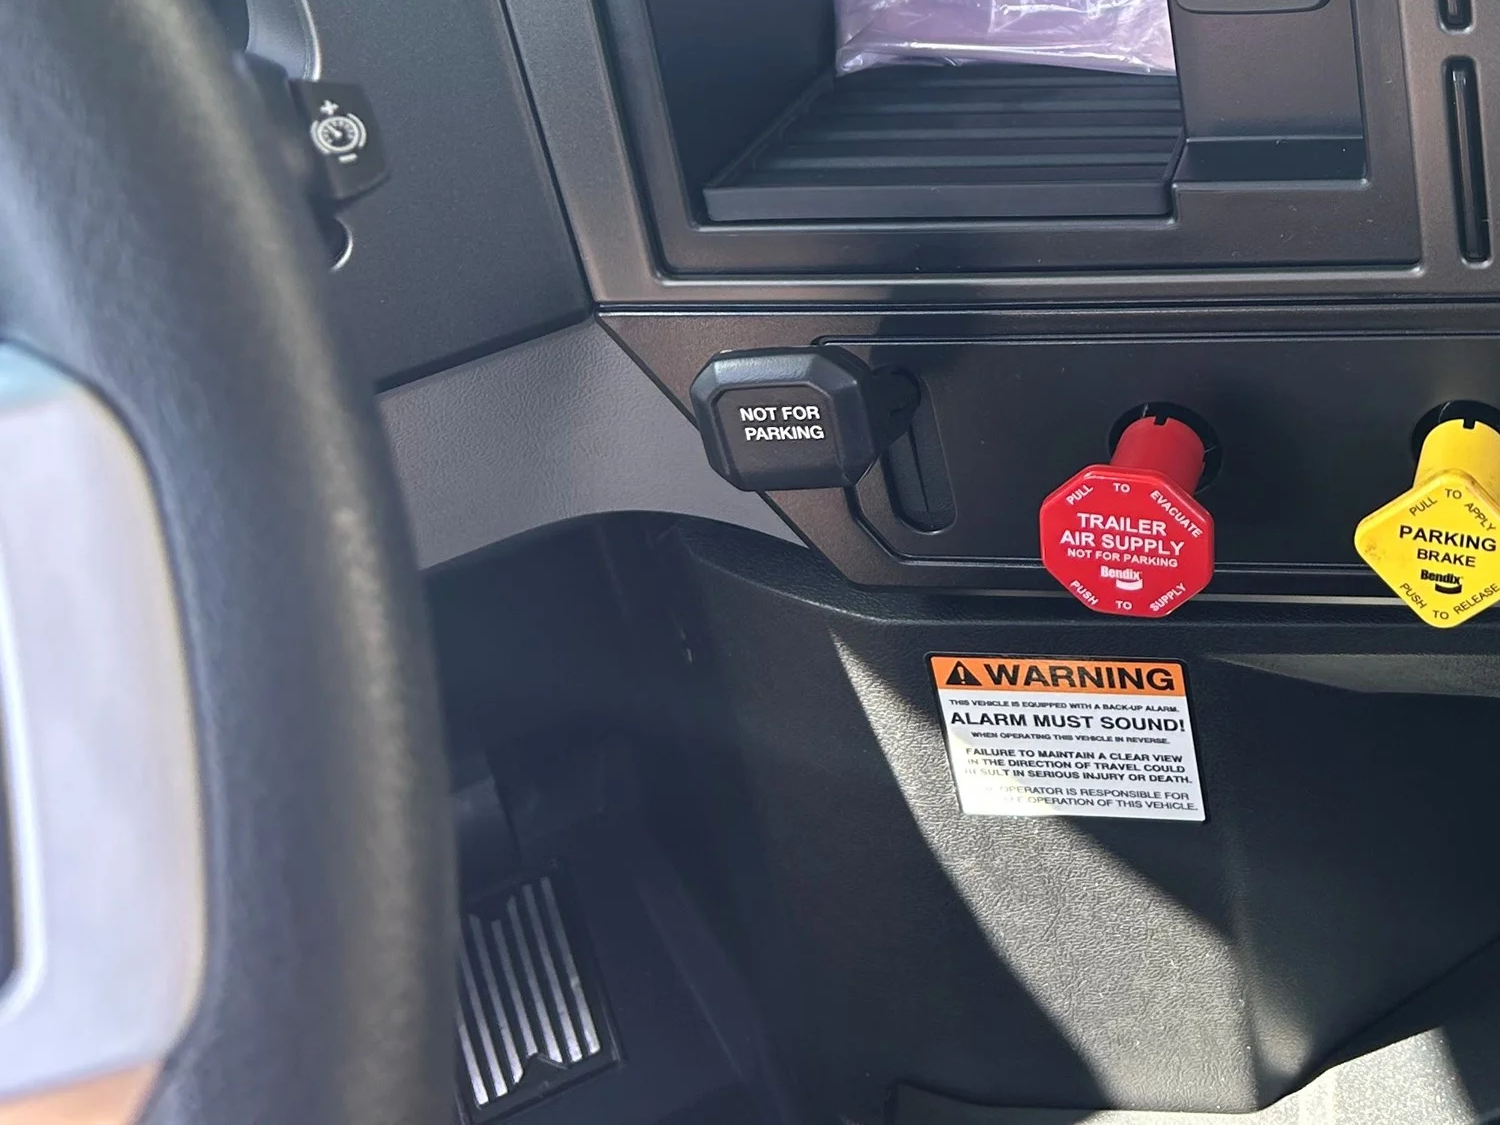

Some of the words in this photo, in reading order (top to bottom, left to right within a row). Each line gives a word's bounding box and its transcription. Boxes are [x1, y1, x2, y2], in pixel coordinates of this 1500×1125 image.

[739, 407, 777, 422] NOT
[781, 405, 821, 421] FOR
[744, 425, 825, 441] PARKING
[1065, 483, 1094, 506] PULL
[1112, 482, 1131, 494] TO
[1150, 490, 1204, 539] EVACUATE
[1408, 496, 1438, 517] PULL
[1444, 488, 1462, 500] TO
[1464, 502, 1496, 532] APPLY
[1076, 512, 1167, 536] TRAILER
[1060, 530, 1096, 547] AIR
[1101, 534, 1185, 556] SUPPLY
[1399, 525, 1497, 552] PARKING
[1067, 547, 1092, 559] NOT
[1095, 550, 1120, 562] FOR
[1123, 553, 1179, 568] PARKING
[1417, 548, 1476, 568] BRAKE
[1100, 565, 1140, 581] Bendix
[1420, 568, 1461, 585] Bendix
[1069, 579, 1099, 606] PUSH
[1115, 600, 1133, 611] TO
[1149, 582, 1187, 612] SUPPLY
[1399, 583, 1428, 609] PUSH
[1432, 610, 1450, 620] TO
[1453, 583, 1500, 615] RELEASE
[984, 663, 1175, 691] WARNING
[951, 712, 1027, 726] ALARM
[1033, 714, 1093, 728] MUST
[1100, 716, 1185, 732] SOUND!
[1000, 732, 1051, 740] OPERATING
[966, 748, 1016, 756] FAILURE
[1018, 749, 1035, 757] TO
[1038, 750, 1095, 759] MAINTAIN
[1098, 752, 1106, 760] A
[1109, 753, 1150, 761] CLEAR
[1152, 754, 1183, 763] VIEW
[1008, 759, 1072, 769] DIRECTION
[1074, 761, 1091, 769] OF
[1094, 762, 1141, 771] TRAVEL
[1144, 764, 1186, 773] COULD
[1012, 769, 1025, 777] IN
[1027, 770, 1080, 779] SERIOUS
[1083, 772, 1125, 781] INJURY
[1128, 774, 1146, 782] OR
[1149, 774, 1192, 783] DEATH.
[1000, 786, 1063, 795] OPERATOR
[1066, 787, 1078, 795] IS
[1079, 788, 1162, 799] RESPONSIBLE
[1164, 792, 1189, 800] FOR
[1028, 796, 1094, 806] OPERATION
[1097, 798, 1113, 807] OF
[1115, 800, 1142, 808] THIS
[1144, 801, 1198, 811] VEHICLE.
